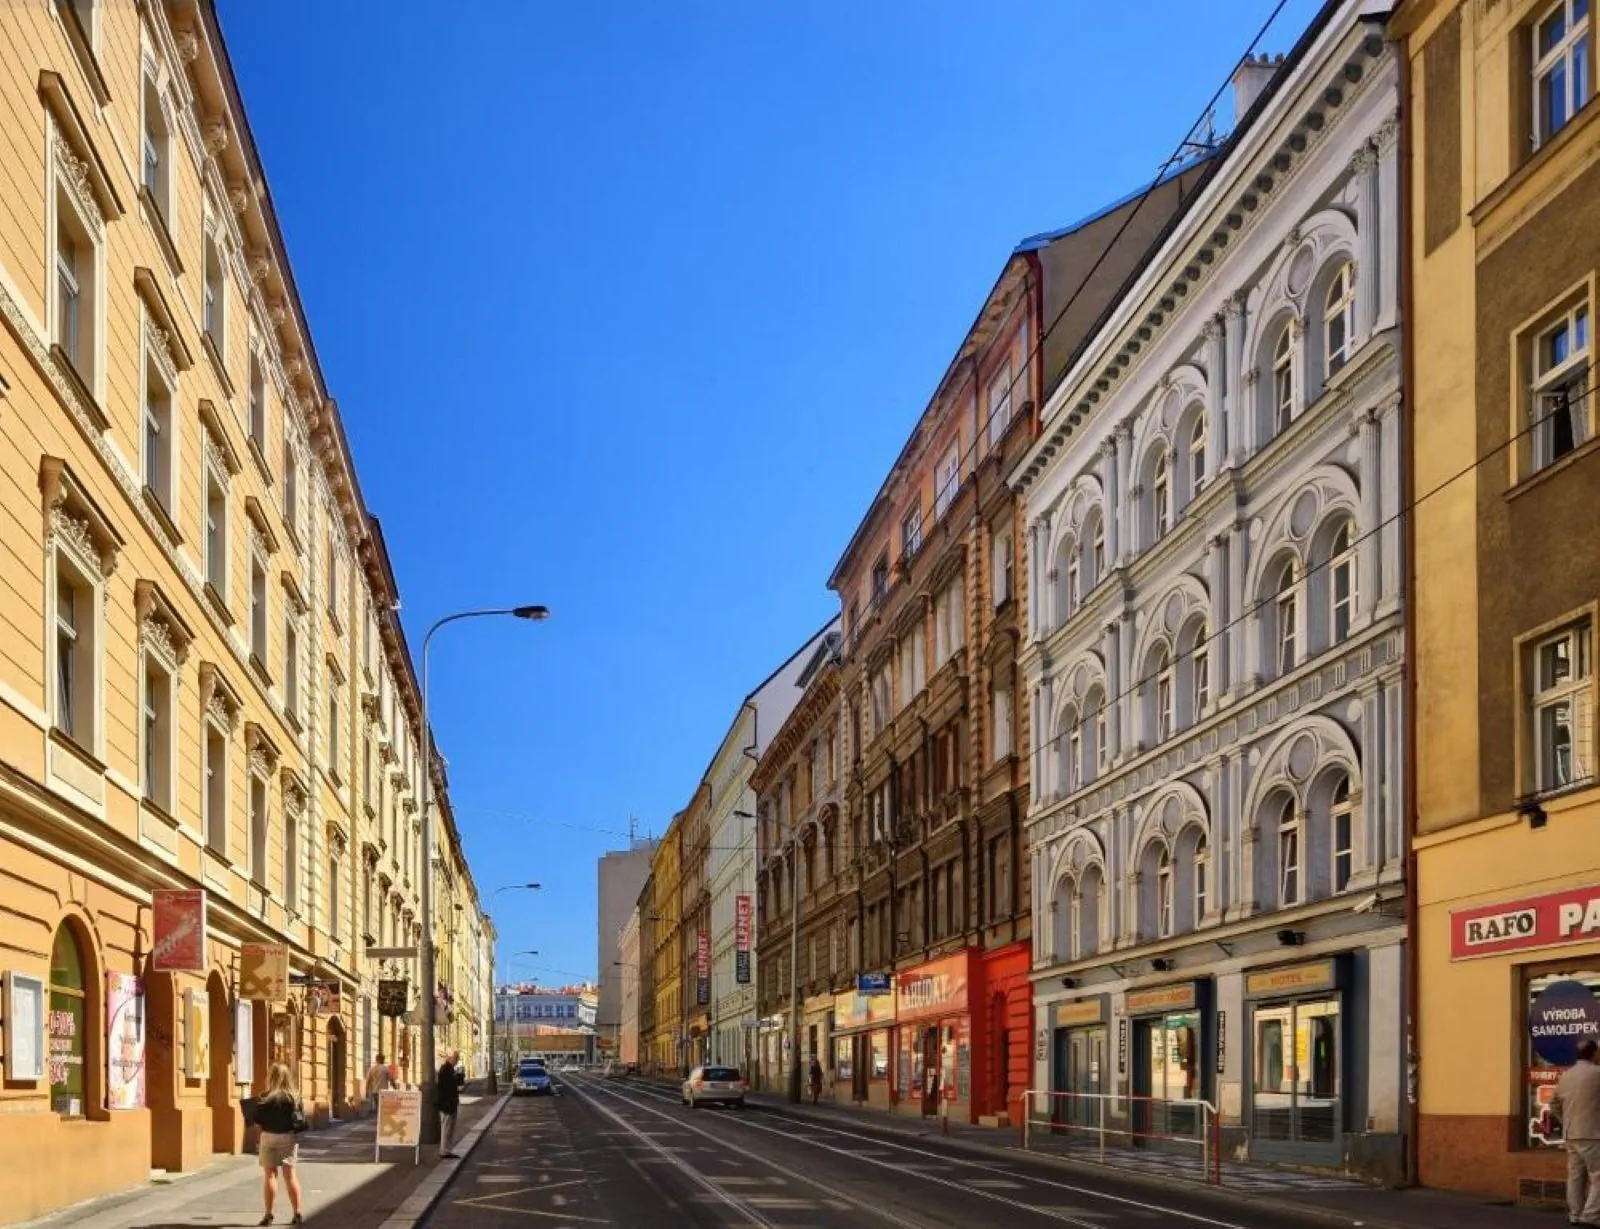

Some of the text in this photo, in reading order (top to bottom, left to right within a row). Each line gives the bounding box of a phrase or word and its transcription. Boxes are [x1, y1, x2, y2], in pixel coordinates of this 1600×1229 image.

[1469, 898, 1600, 942] RAFO PA
[1543, 1006, 1586, 1021] VÝROBA
[1532, 1022, 1598, 1037] SAMOLEPEK
